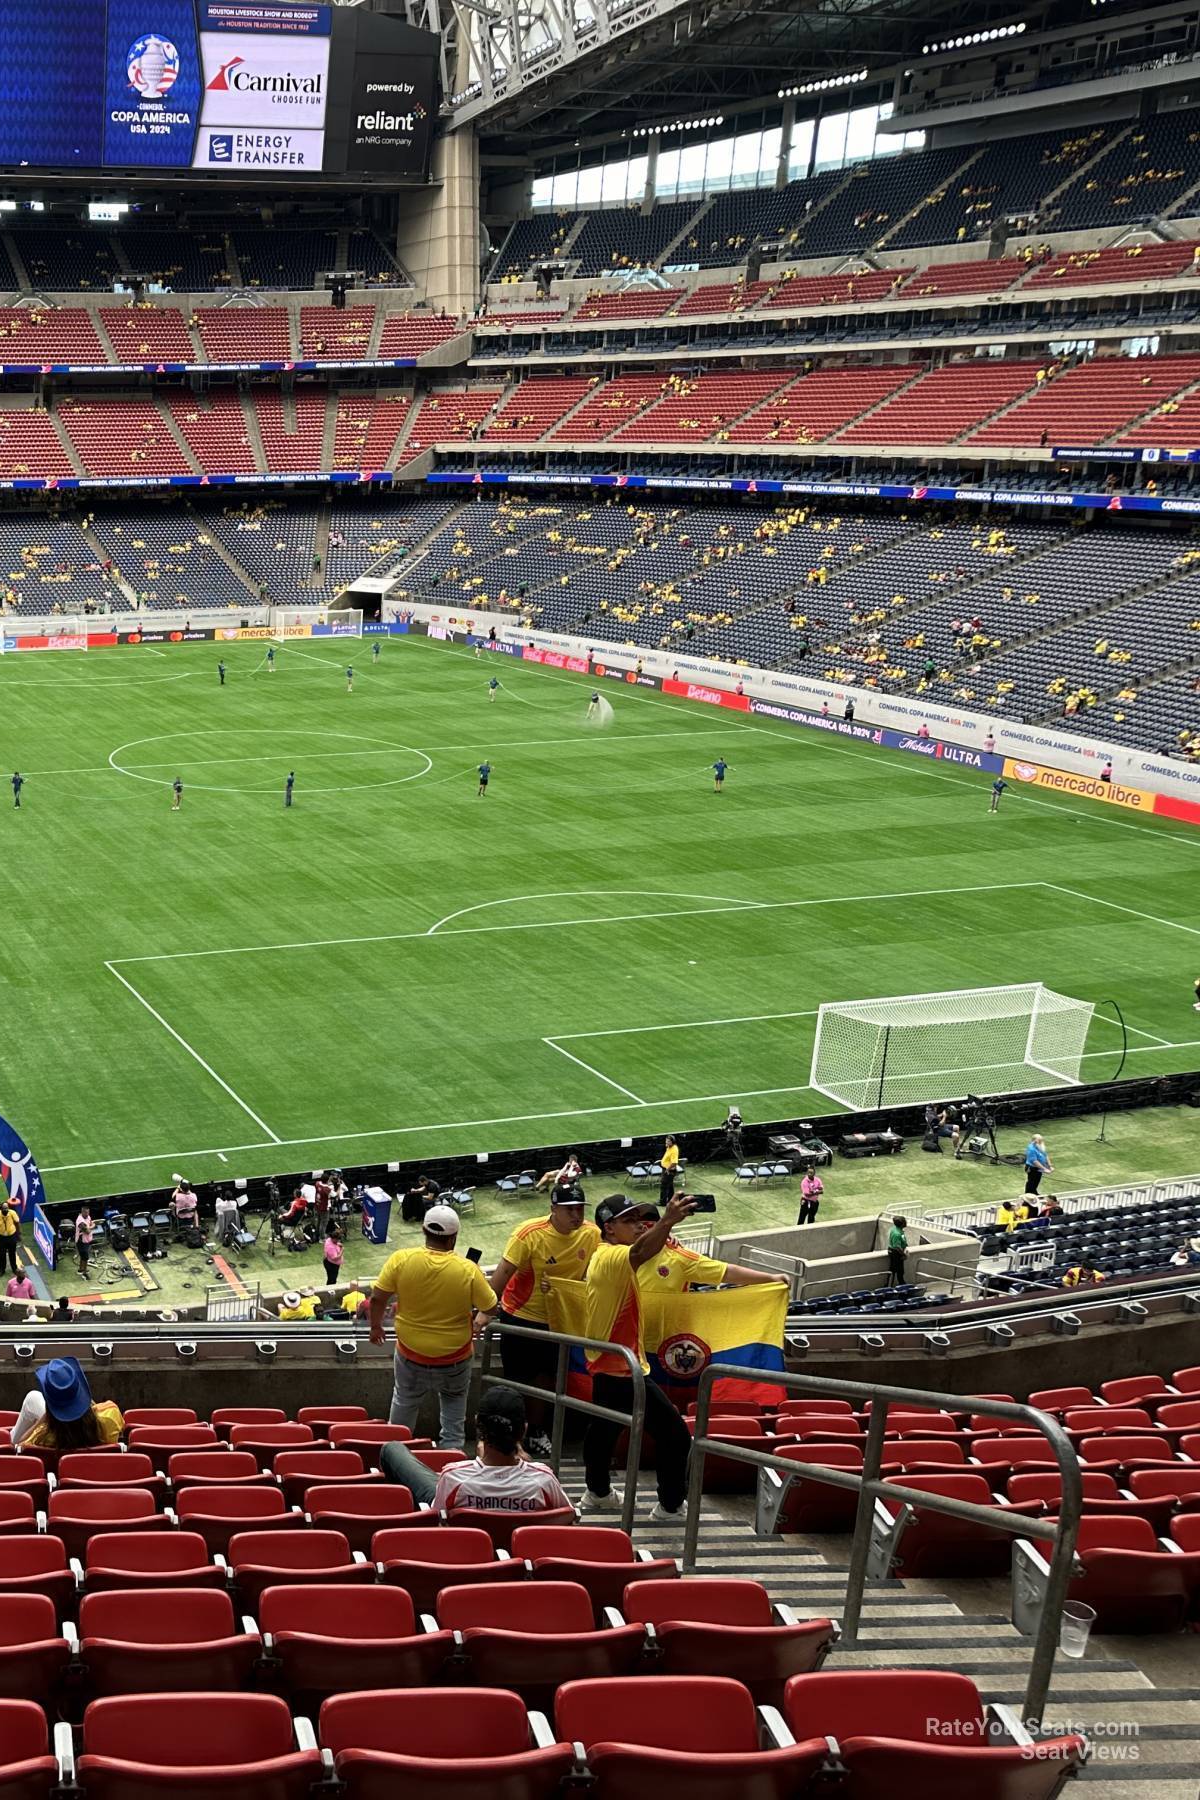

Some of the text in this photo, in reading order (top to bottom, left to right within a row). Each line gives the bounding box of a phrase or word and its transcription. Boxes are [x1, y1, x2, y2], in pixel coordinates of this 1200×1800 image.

[234, 72, 322, 93] Carnival
[366, 83, 415, 94] powered by
[272, 95, 321, 104] CHOOSE FUN
[111, 111, 190, 124] COPA AMERICA
[357, 111, 414, 130] reliant
[130, 124, 170, 134] USA 2024
[236, 135, 292, 148] ENERGY
[365, 136, 380, 144] NRG
[381, 138, 412, 146] company
[236, 151, 304, 164] TRANSFER
[241, 626, 304, 638] mercado libre
[496, 643, 514, 654] ULTRA
[687, 684, 722, 704] Betano
[756, 704, 870, 738] CONMEBOL COPA AMERICA USA 2024
[878, 702, 908, 714] CONMEBOL
[909, 709, 924, 718] COPA
[925, 712, 950, 724] AMERICA
[1000, 729, 1035, 744] CONMEBOL
[1036, 737, 1052, 748] COPA
[1054, 742, 1082, 755] AMERICA
[899, 737, 982, 766] Michelob ULTRA
[1141, 762, 1180, 780] CONMEBOL
[1041, 772, 1141, 806] mercado libre
[467, 1494, 536, 1511] FRANCISCO
